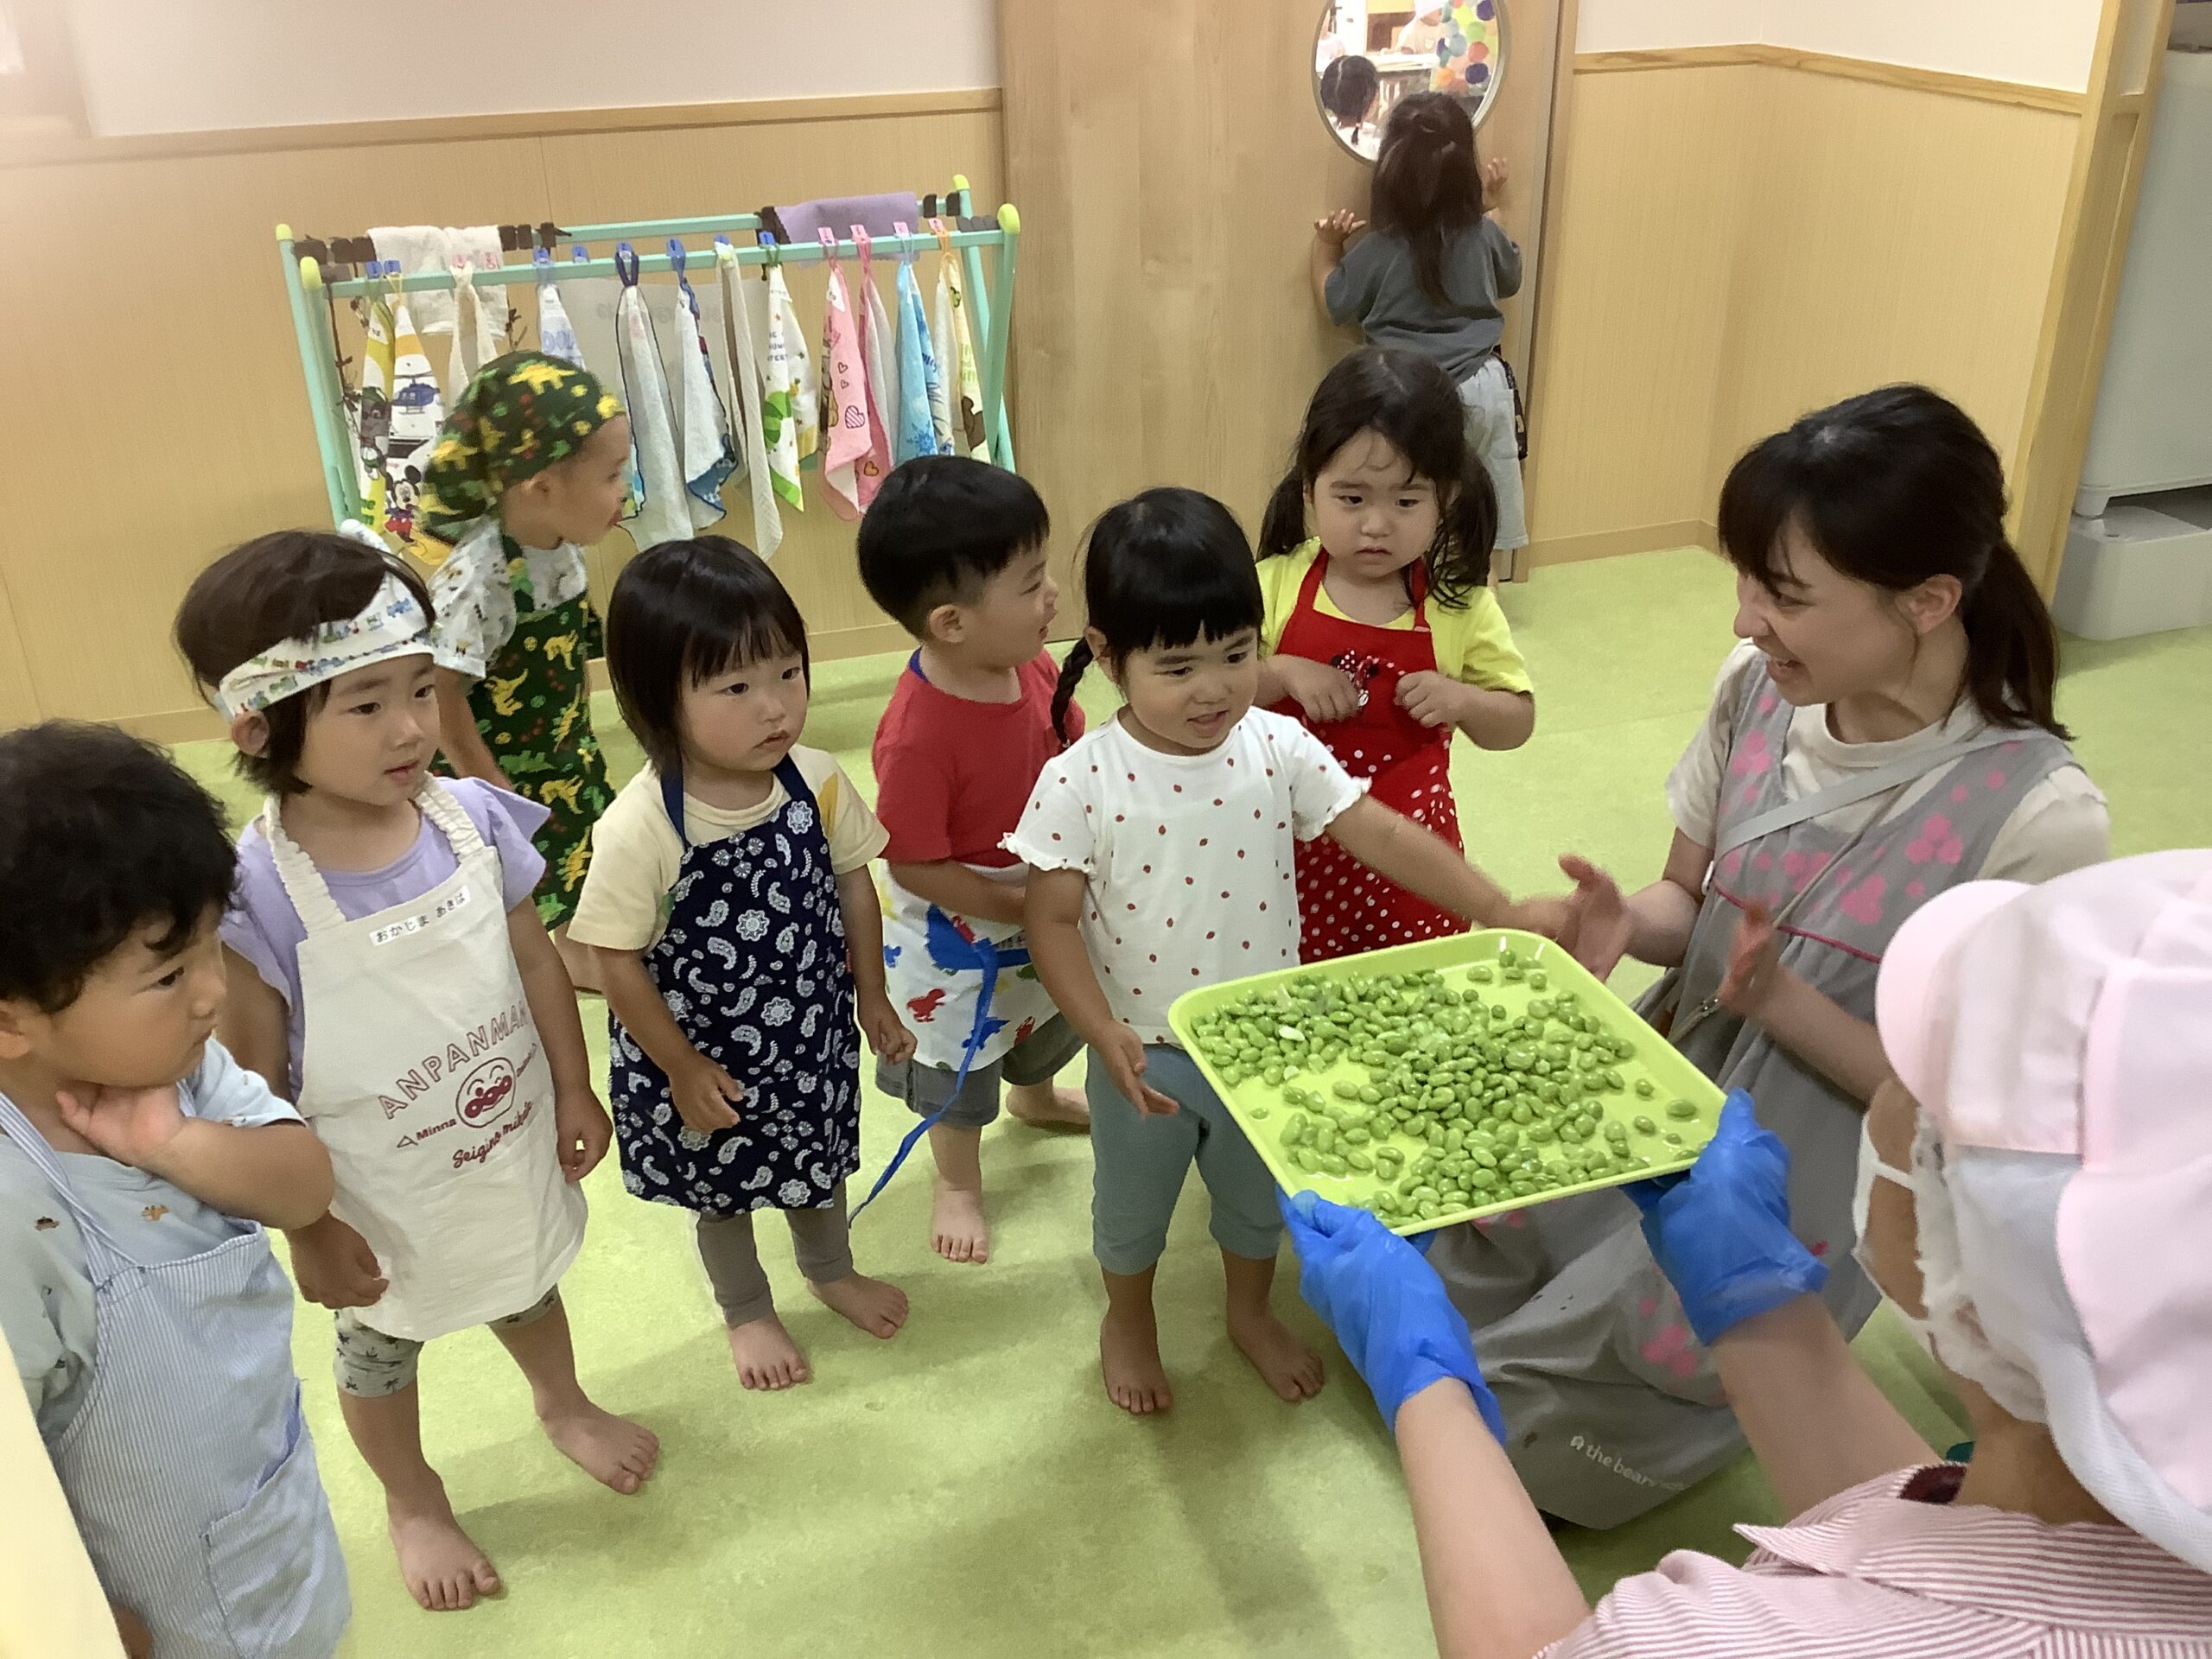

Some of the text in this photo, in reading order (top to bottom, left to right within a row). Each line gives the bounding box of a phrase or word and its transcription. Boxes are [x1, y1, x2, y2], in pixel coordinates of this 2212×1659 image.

[376, 914, 429, 943] おかじま
[416, 1118, 457, 1141] Minna
